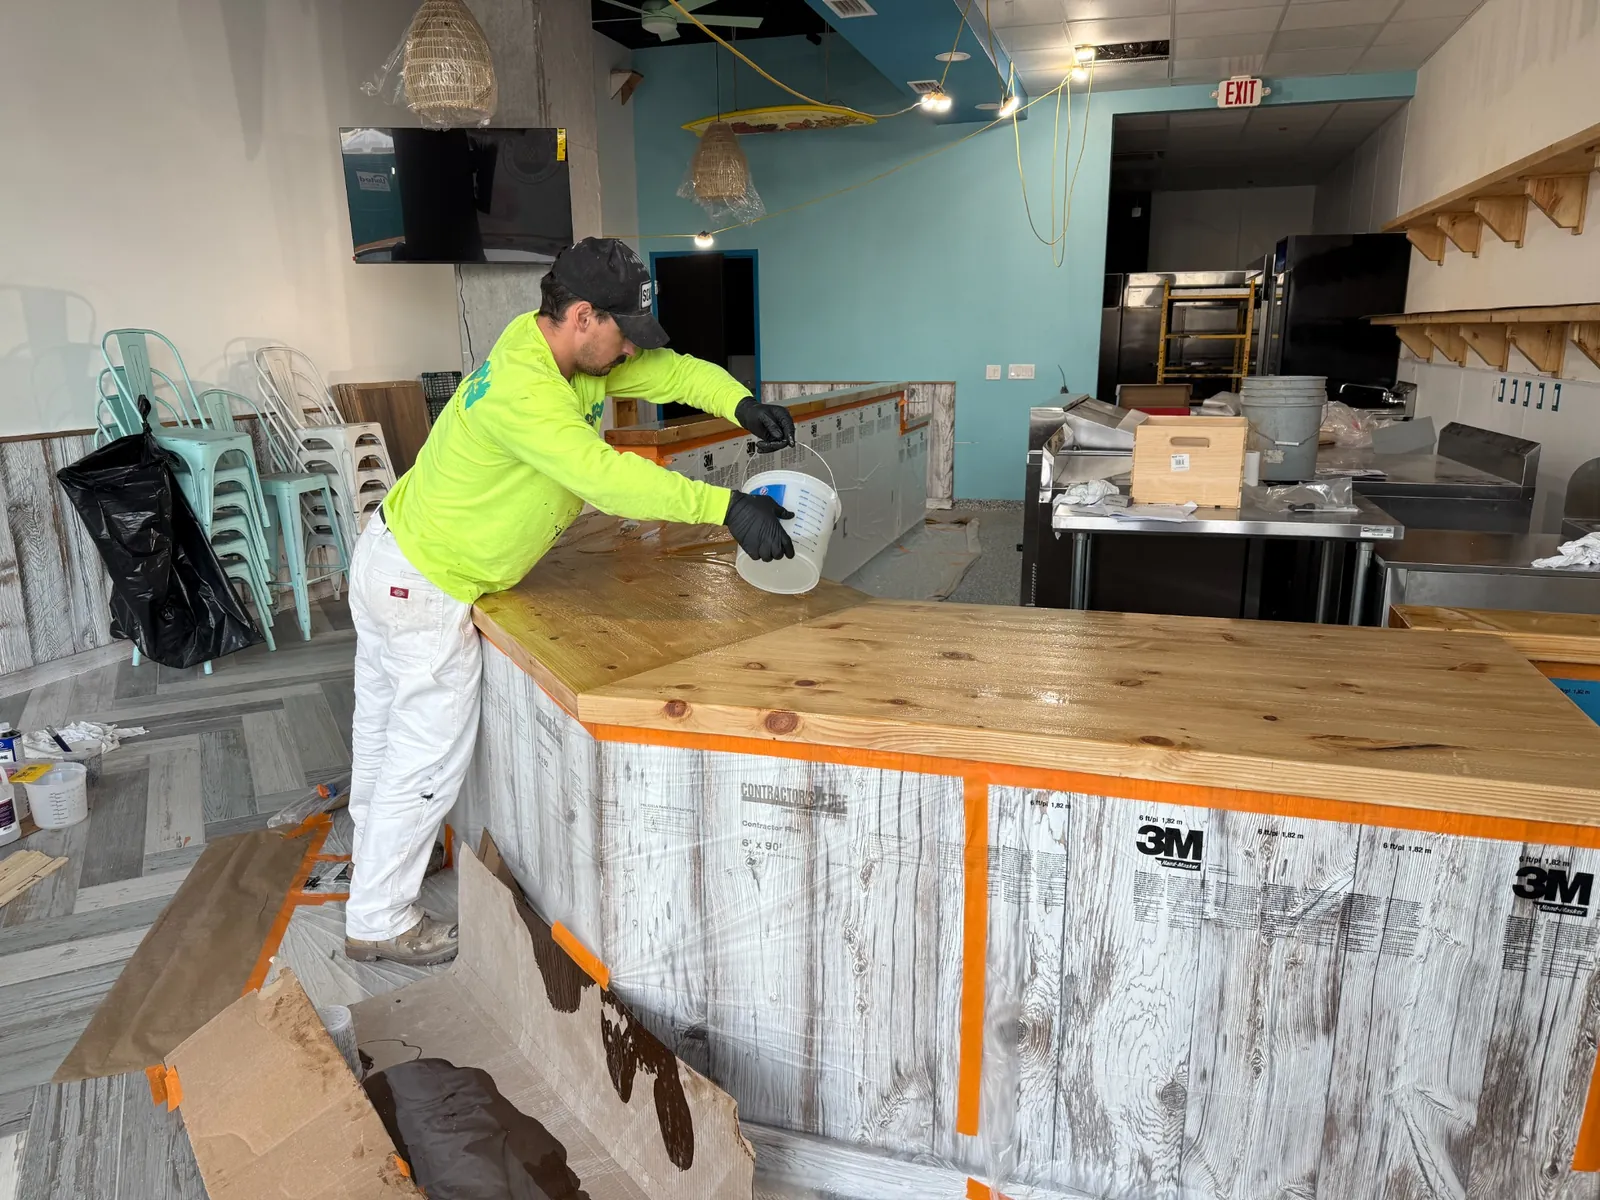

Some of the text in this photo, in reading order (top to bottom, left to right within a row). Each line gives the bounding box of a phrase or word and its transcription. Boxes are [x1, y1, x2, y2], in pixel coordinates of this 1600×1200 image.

[1225, 80, 1257, 105] EXIT
[704, 453, 714, 468] 3M
[741, 782, 848, 809] CONTRACTOR'S EDGE
[1145, 815, 1158, 823] ft/pi
[742, 820, 801, 834] Contractor Film
[742, 839, 752, 847] 6'
[765, 841, 782, 851] 90'
[1136, 824, 1204, 860] 3M
[1390, 842, 1404, 851] ft/pi
[1161, 860, 1199, 870] Hand-Masker
[1512, 866, 1595, 906] 3M
